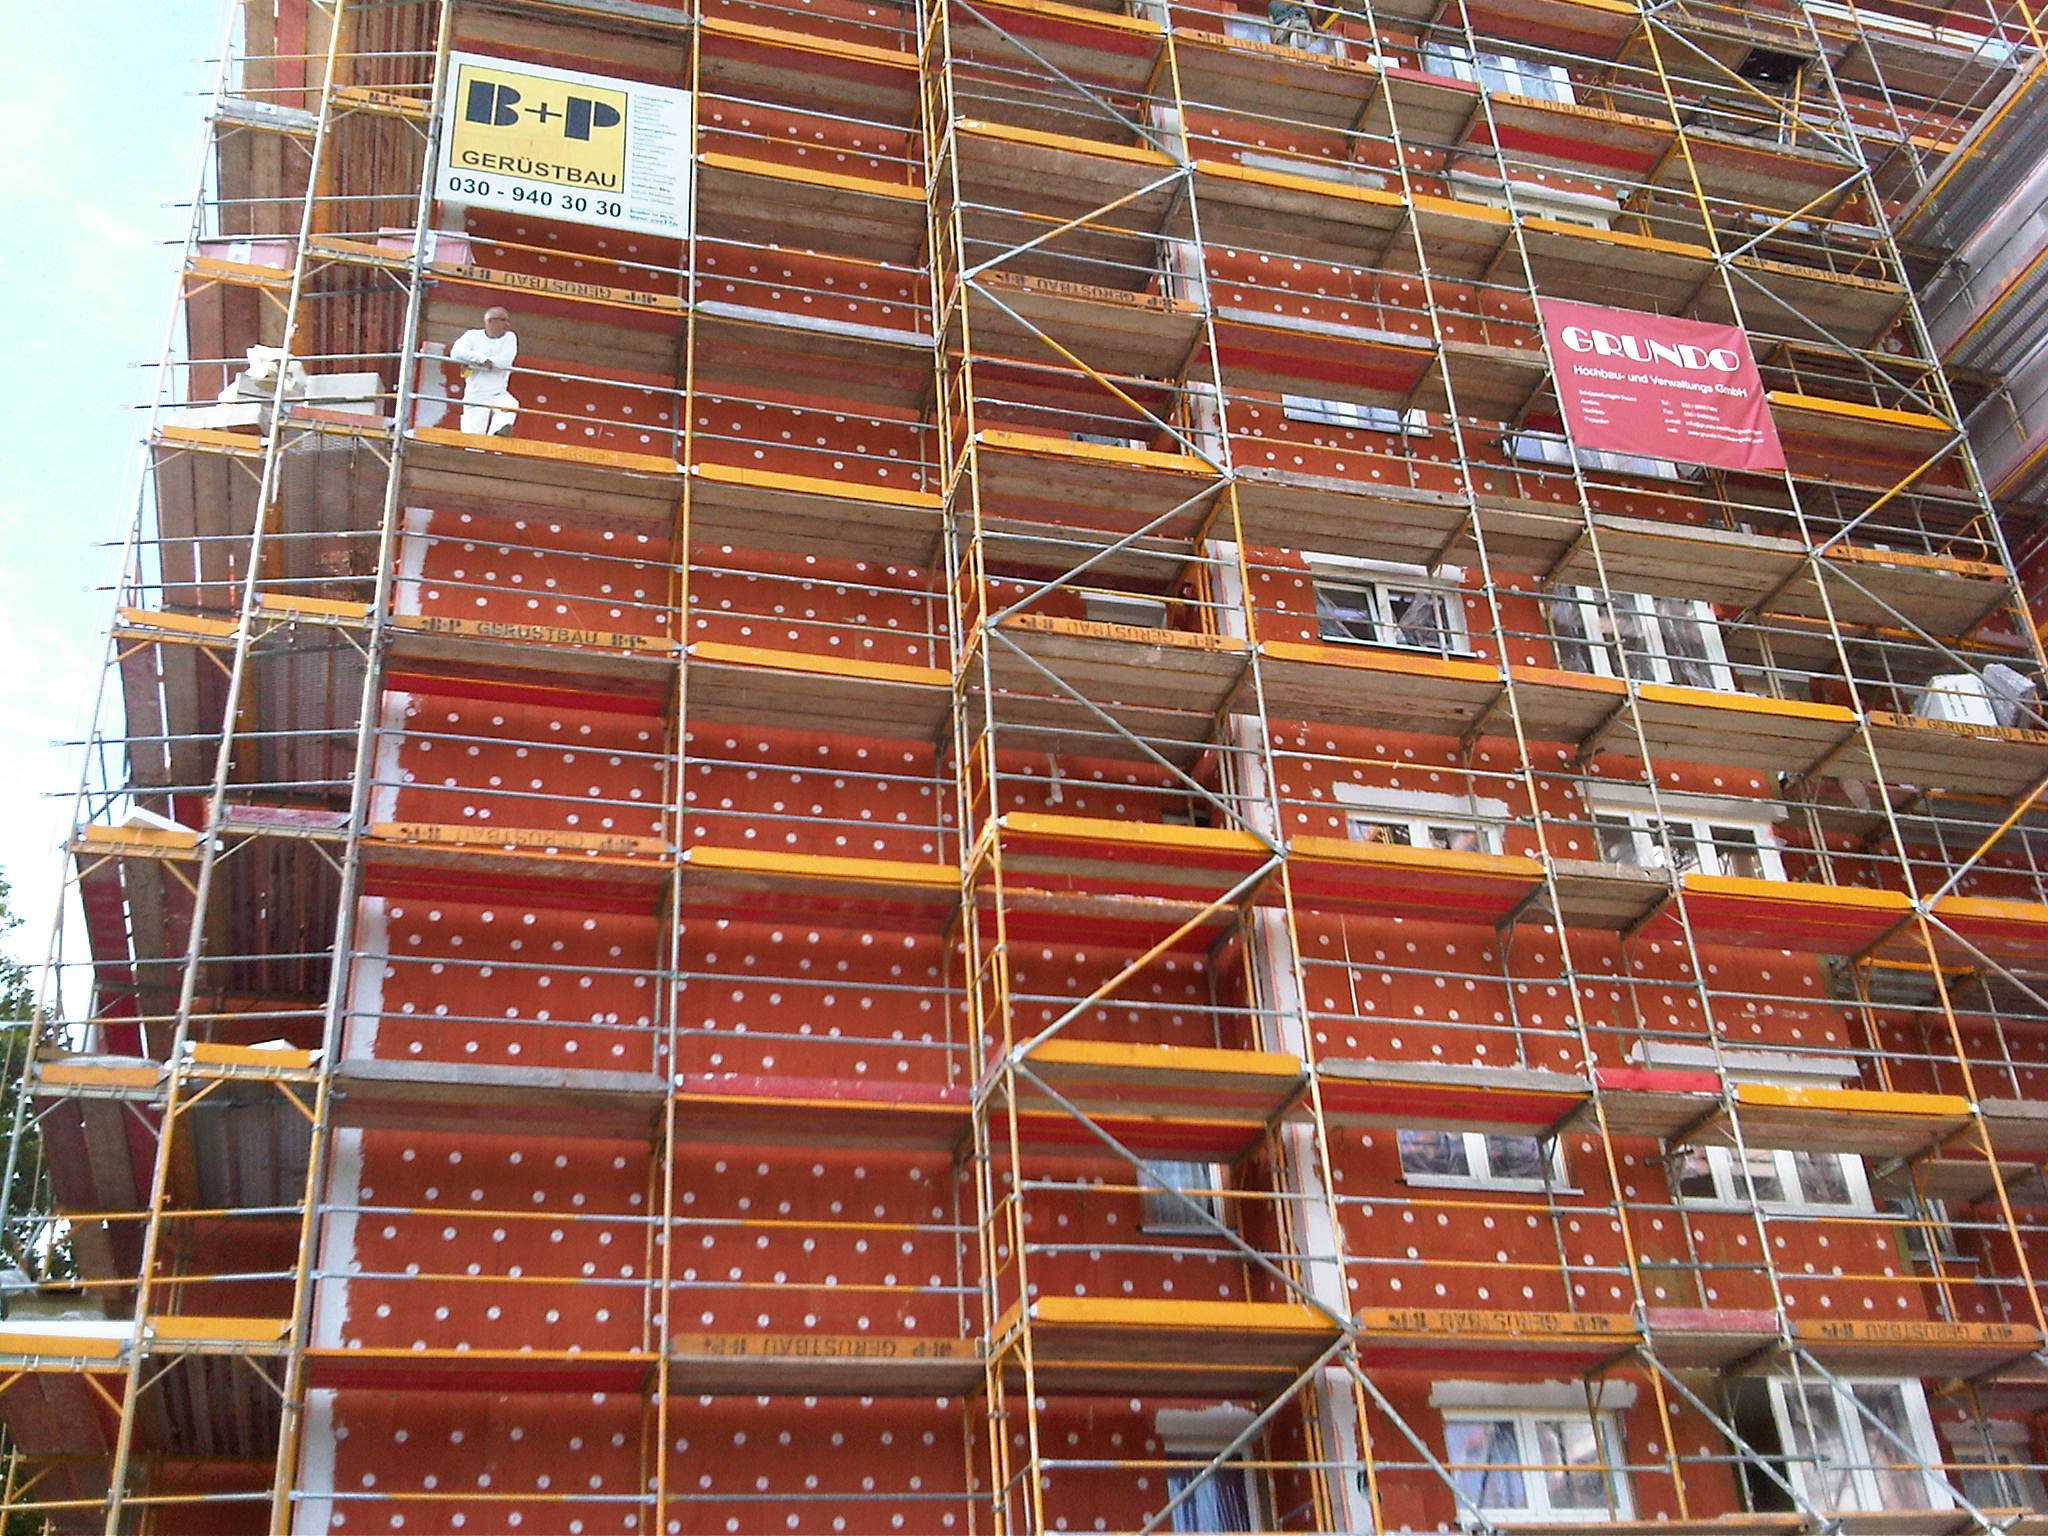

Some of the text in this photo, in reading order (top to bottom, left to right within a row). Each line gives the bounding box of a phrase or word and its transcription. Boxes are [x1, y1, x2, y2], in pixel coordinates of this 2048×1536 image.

[465, 79, 621, 141] B+P
[461, 149, 617, 188] GERÜSTBAU
[449, 176, 490, 196] 030
[512, 186, 553, 207] 940
[561, 195, 587, 212] 30
[596, 200, 622, 218] 30
[1561, 326, 1740, 372] GRUNDO
[1573, 365, 1748, 398] Hochbau- und Verwaltungs GmbH
